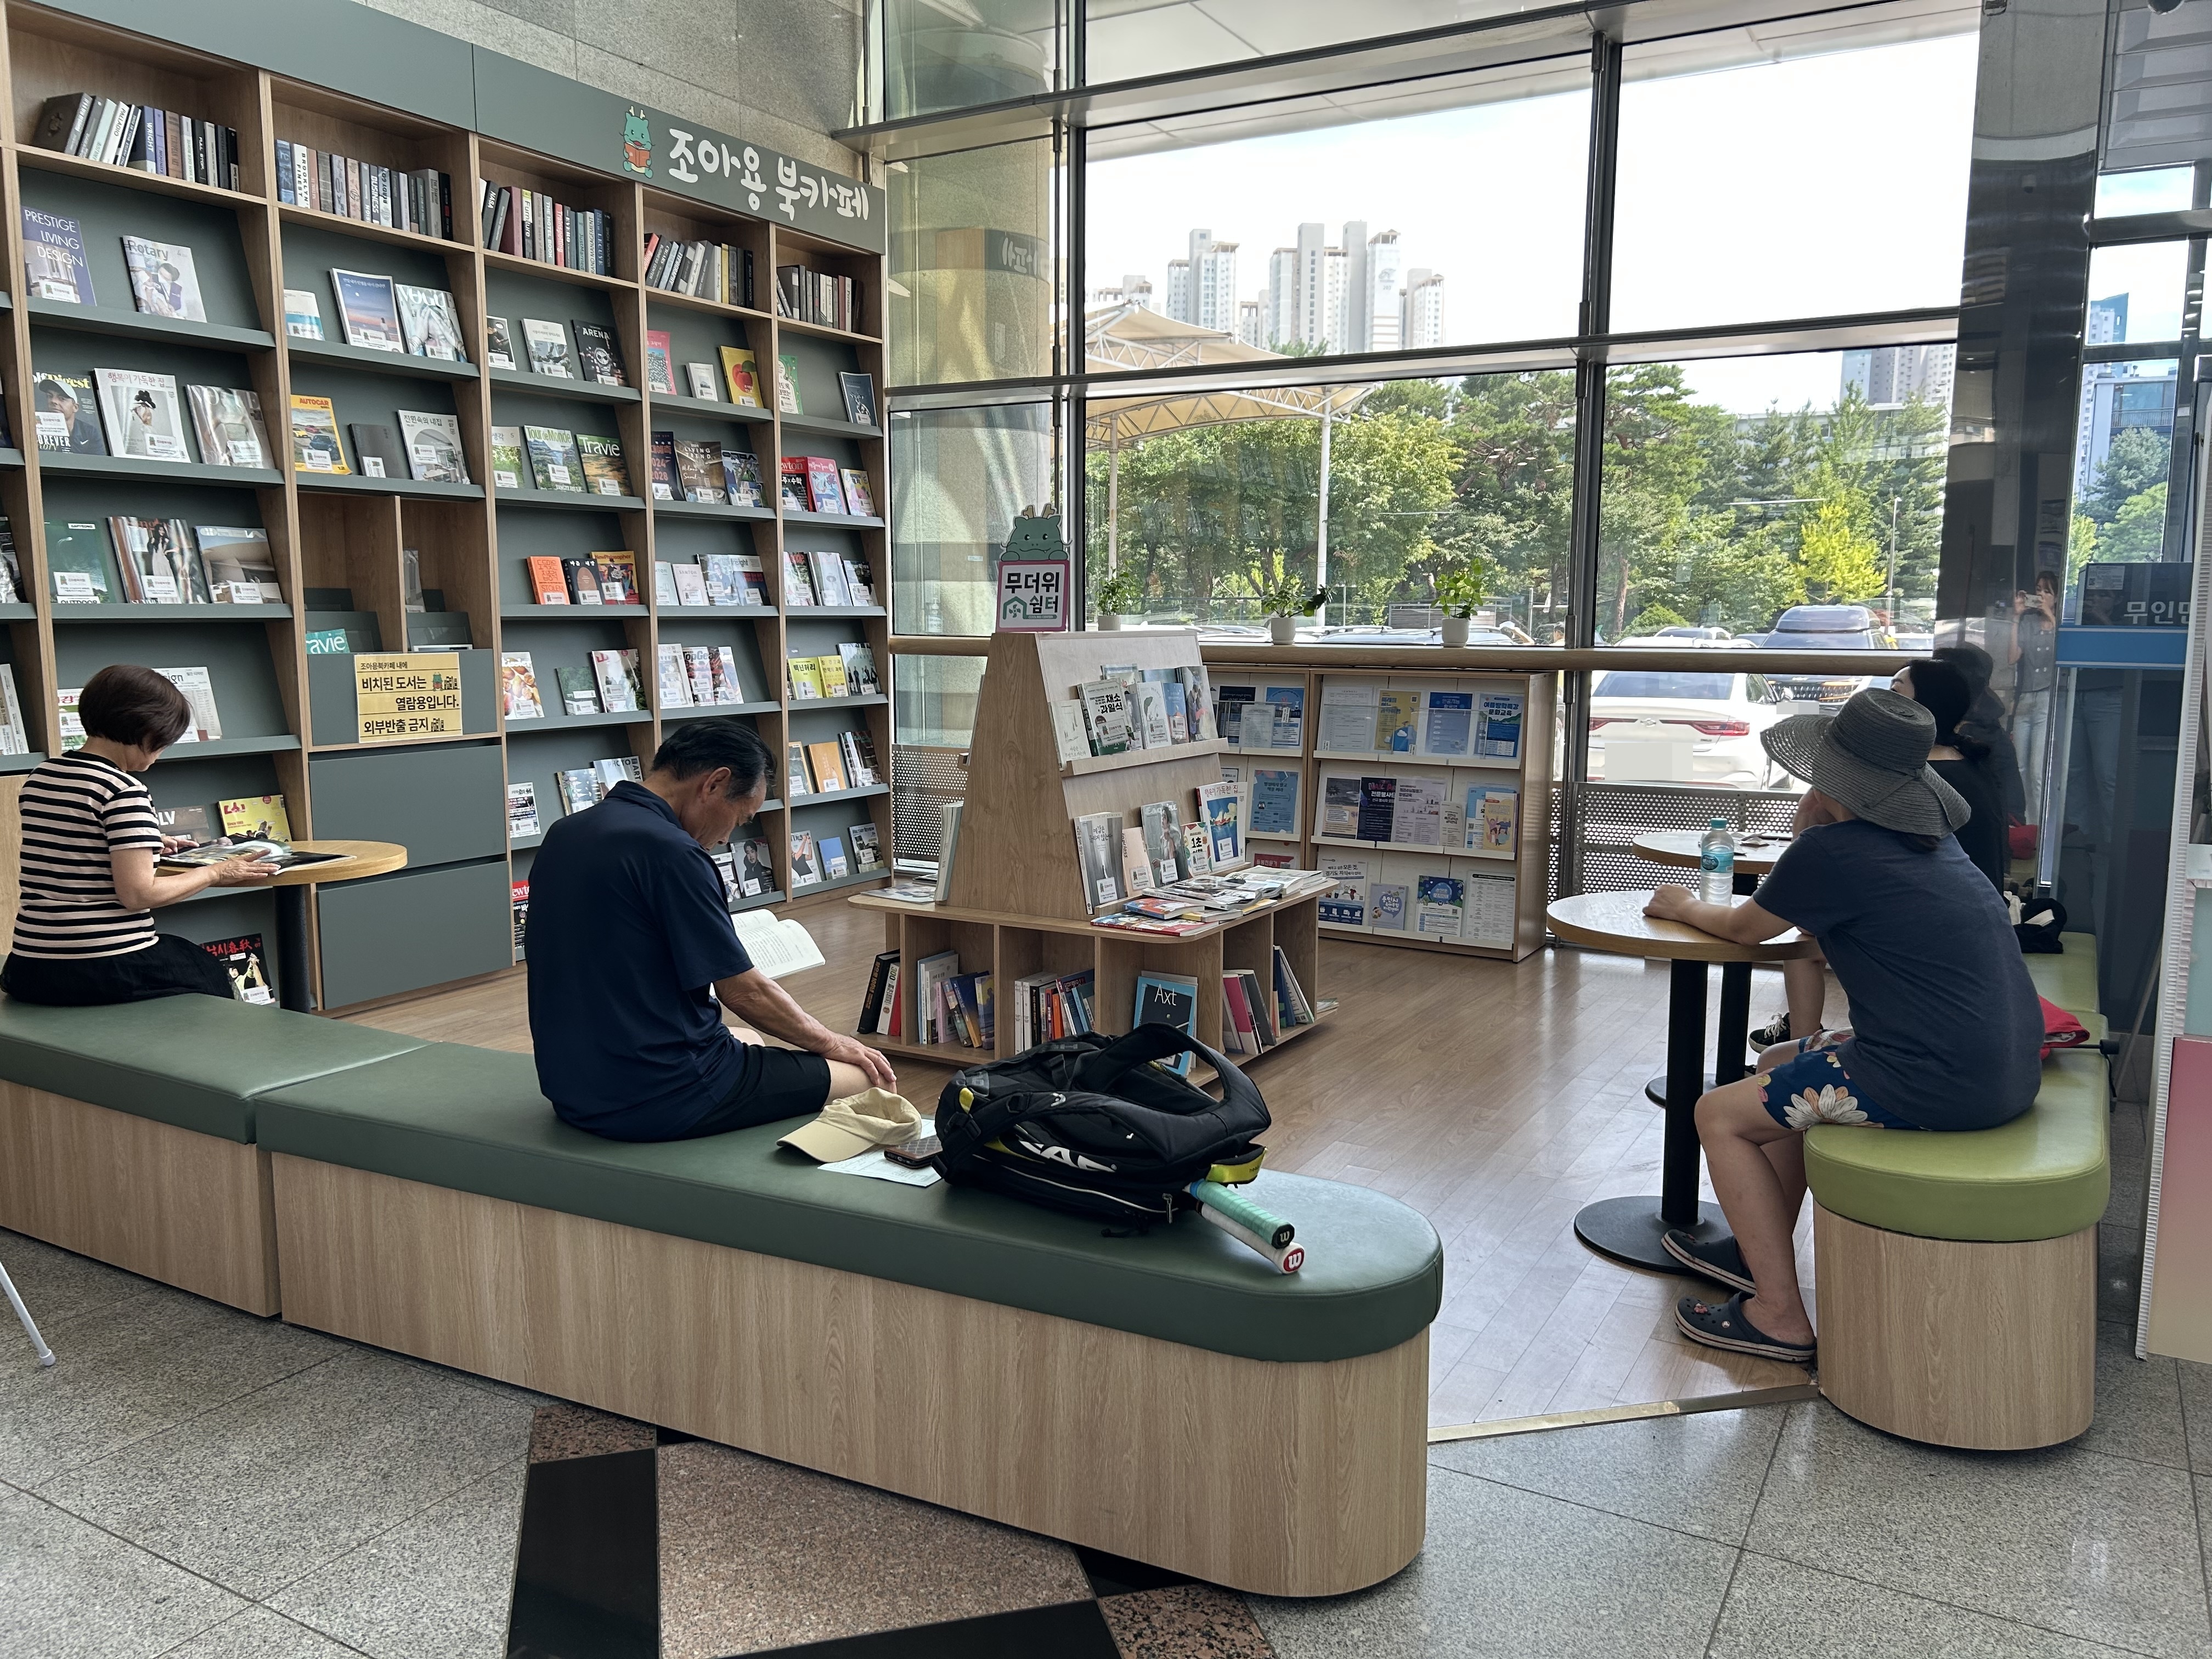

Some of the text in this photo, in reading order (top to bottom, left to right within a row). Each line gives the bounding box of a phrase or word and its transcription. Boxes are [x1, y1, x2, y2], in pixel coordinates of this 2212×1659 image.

[115, 108, 126, 137] PALLADIO
[146, 122, 154, 152] WRIGHT
[668, 128, 869, 221] 조아용 북카페
[371, 176, 379, 214] BUSINESS
[488, 190, 497, 209] NASA
[24, 209, 77, 233] PRESTIGE
[40, 230, 80, 250] LIVING
[37, 245, 83, 268] DESIGN
[127, 239, 168, 261] Rotary
[669, 252, 684, 286] TYPOGRAPHY
[583, 327, 610, 339] ARENA
[108, 372, 165, 387] 행복이 가득한 집
[299, 398, 329, 406] AUTOCAR
[526, 427, 542, 439] Tour
[549, 430, 572, 444] Monde
[578, 437, 620, 456] Travie
[1005, 572, 1060, 594] 무더위
[1029, 595, 1059, 614] 쉼터
[360, 662, 396, 670] 조아용북카페
[793, 663, 816, 672] 백년허리
[362, 675, 427, 691] 비치된 도서는
[396, 694, 459, 711] 열람용입니다.
[1105, 693, 1121, 703] 채소
[1483, 702, 1519, 710] 여름방학특강
[364, 717, 429, 735] 외부반출 금지
[632, 765, 641, 780] ART
[1216, 785, 1232, 795] 가득한
[1233, 785, 1238, 794] 집
[1191, 837, 1202, 848] 1초
[1154, 984, 1177, 1006] Axt
